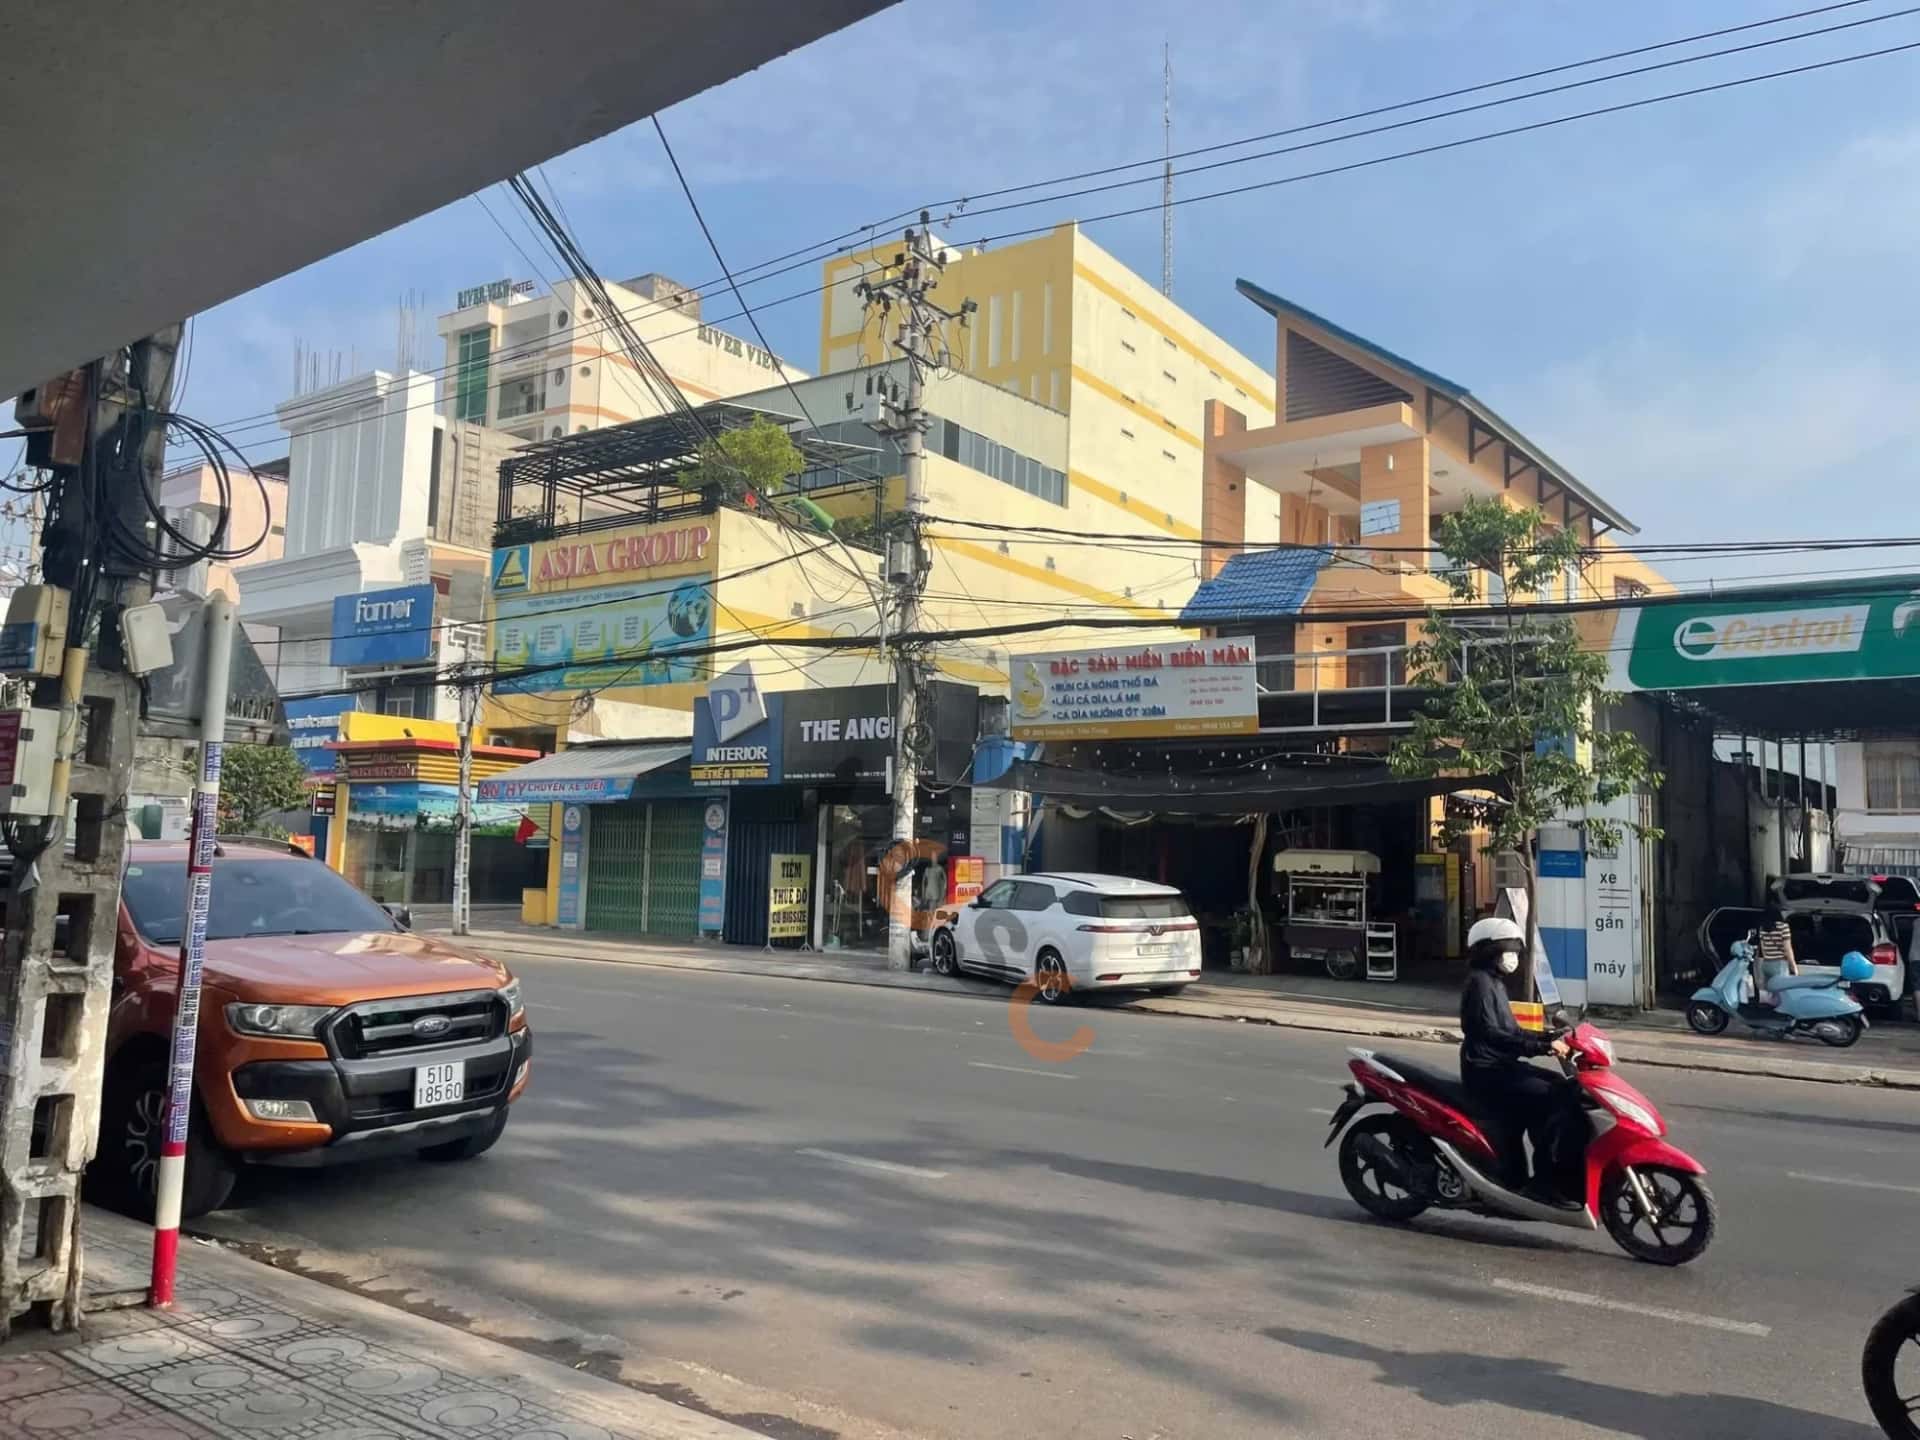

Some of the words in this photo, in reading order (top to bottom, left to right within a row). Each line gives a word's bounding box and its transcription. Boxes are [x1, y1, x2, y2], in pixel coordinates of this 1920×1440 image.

[697, 324, 743, 358] RIVER
[745, 342, 783, 374] VIEW
[537, 542, 600, 584] ASIA
[606, 525, 711, 573] GROUP
[1722, 614, 1855, 651] Castrol
[800, 719, 841, 742] THE
[844, 716, 896, 741] ANG
[706, 746, 768, 761] INTERIOR
[505, 782, 528, 796] HY
[1600, 872, 1617, 884] xe
[1595, 911, 1624, 932] gắn
[1594, 960, 1626, 978] máy
[427, 1064, 453, 1085] 51D
